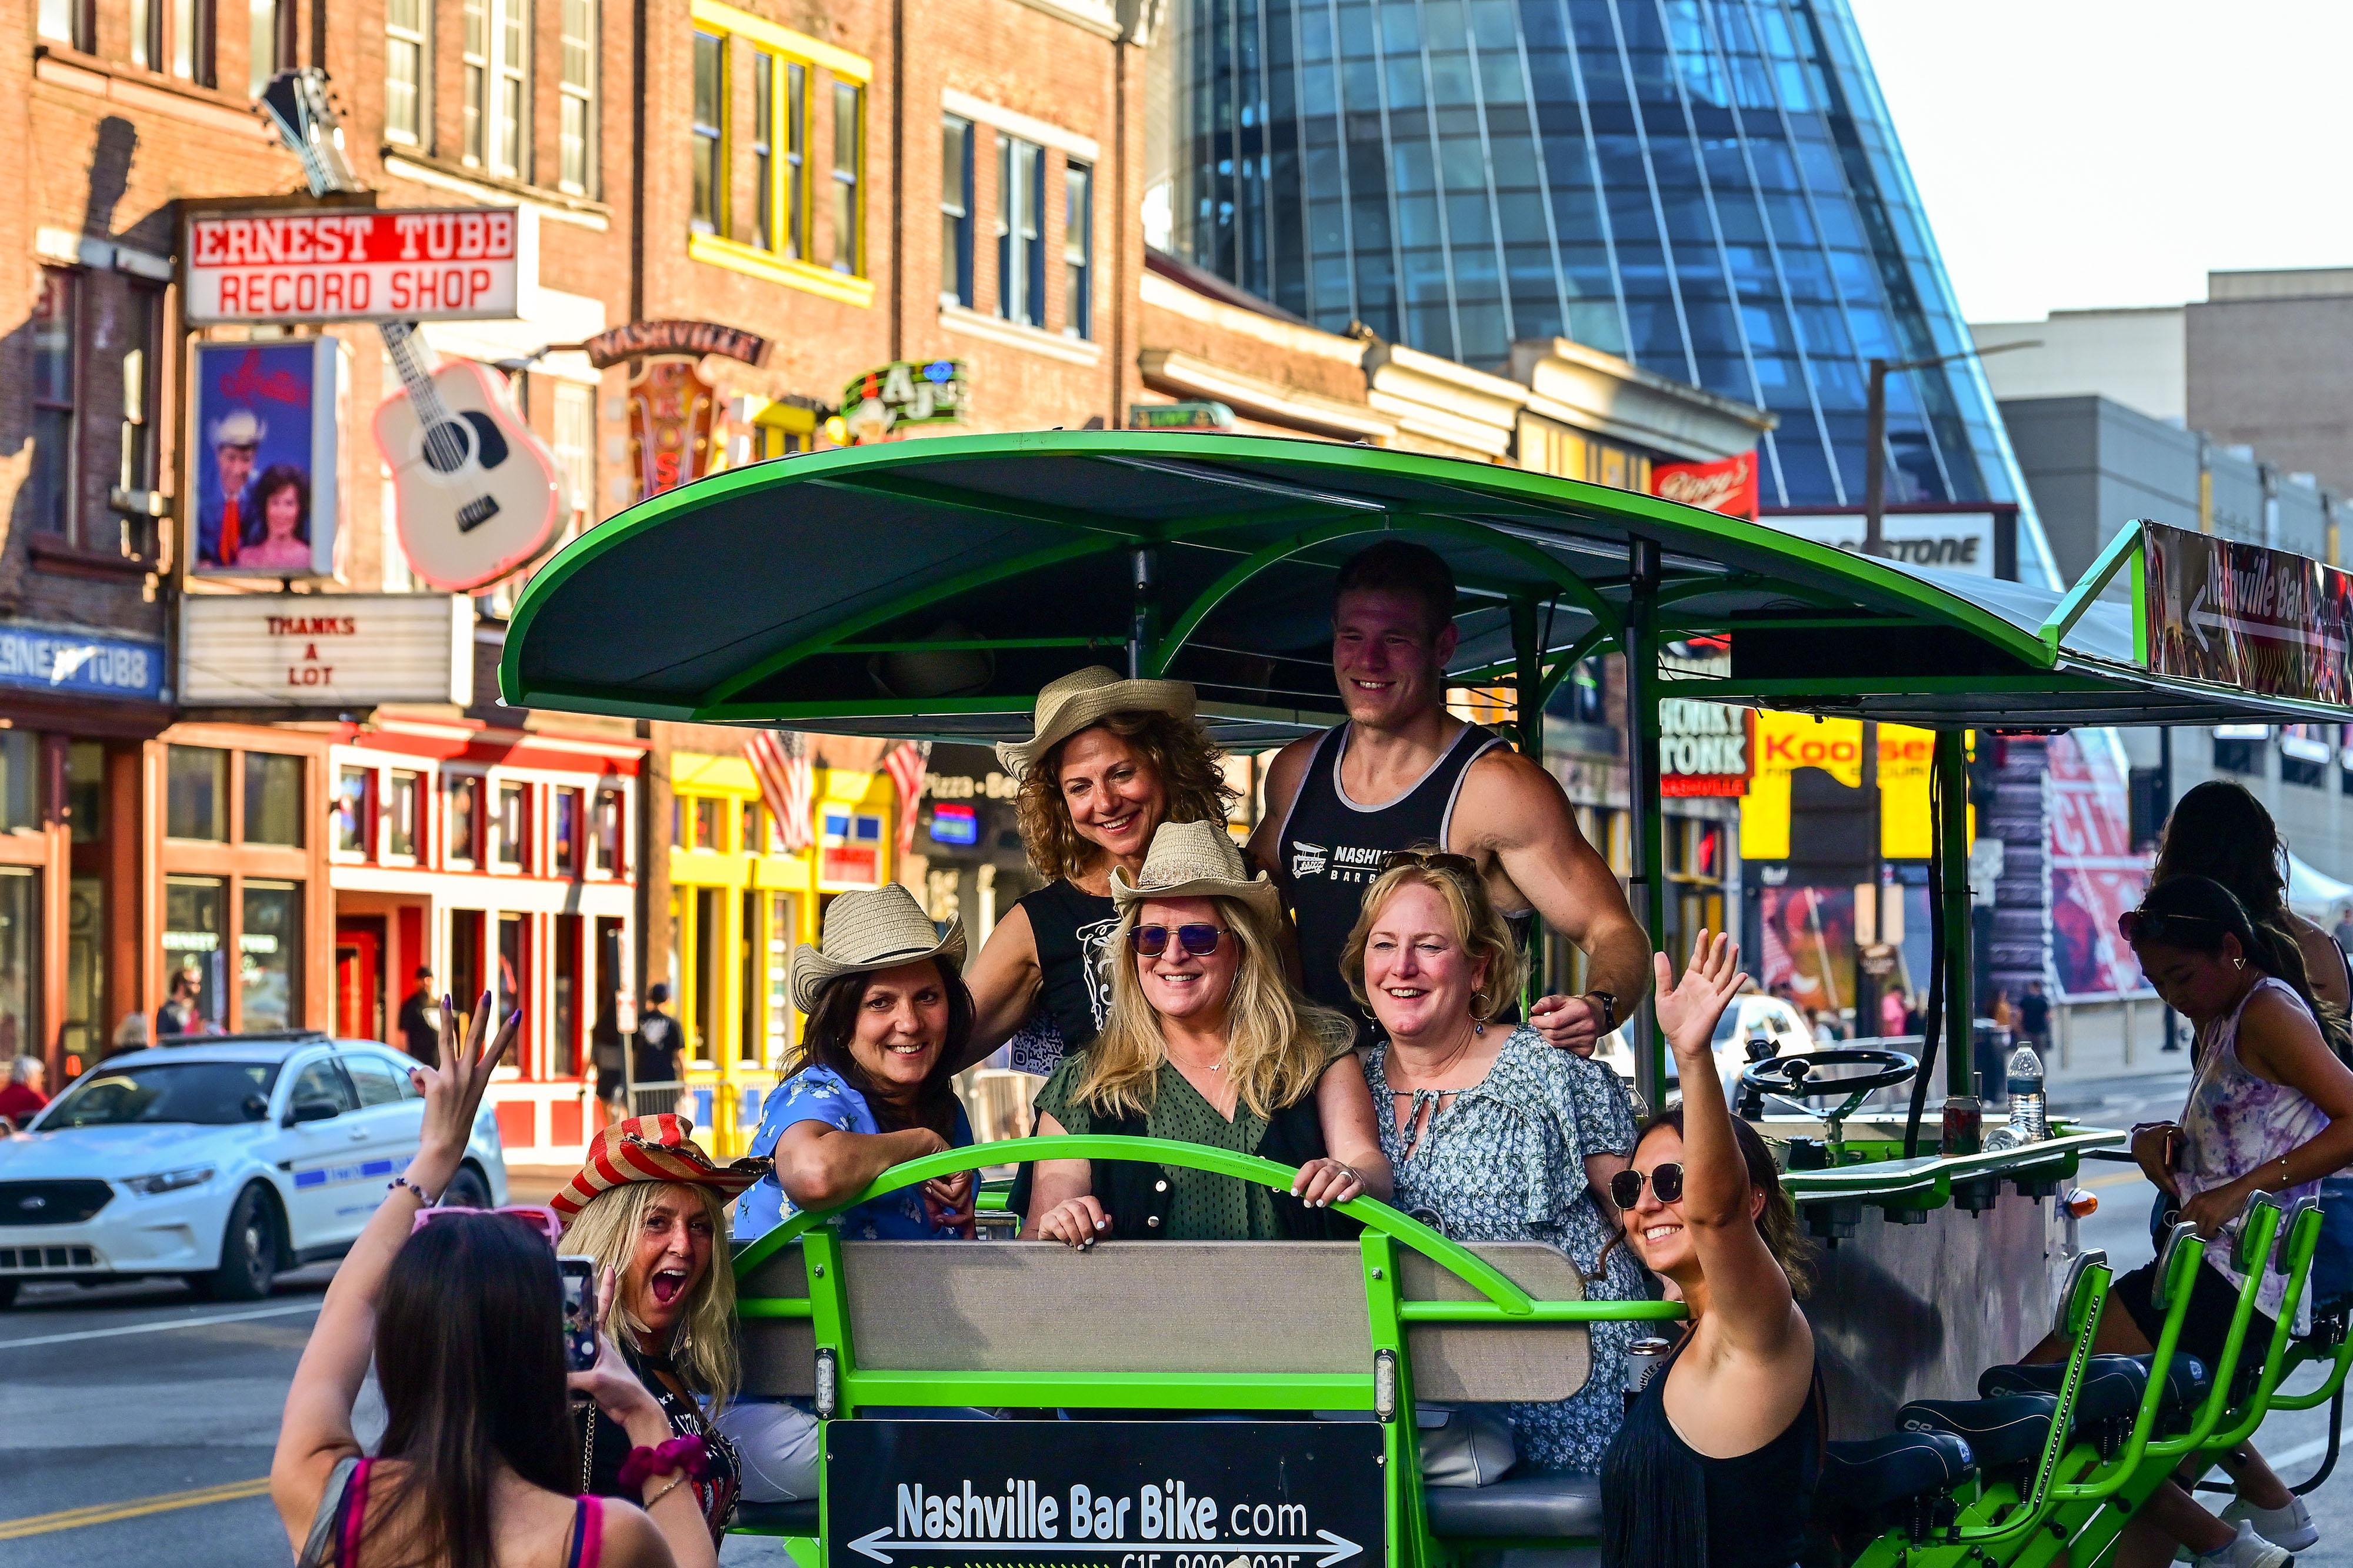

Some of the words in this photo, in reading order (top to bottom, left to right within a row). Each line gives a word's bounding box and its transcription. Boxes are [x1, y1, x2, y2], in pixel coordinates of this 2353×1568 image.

[196, 217, 373, 265] ERNEST
[396, 213, 513, 259] TUBB
[220, 272, 370, 313] RECORD
[391, 269, 491, 309] SHOP
[590, 322, 762, 361] NASHVILLE
[2207, 550, 2275, 618] Nashville
[266, 616, 356, 636] THANKS
[305, 643, 318, 660] A
[288, 667, 333, 686] LOT
[1330, 870, 1361, 883] BAR
[896, 1477, 1059, 1539] Nashville
[1070, 1484, 1131, 1540] Bar
